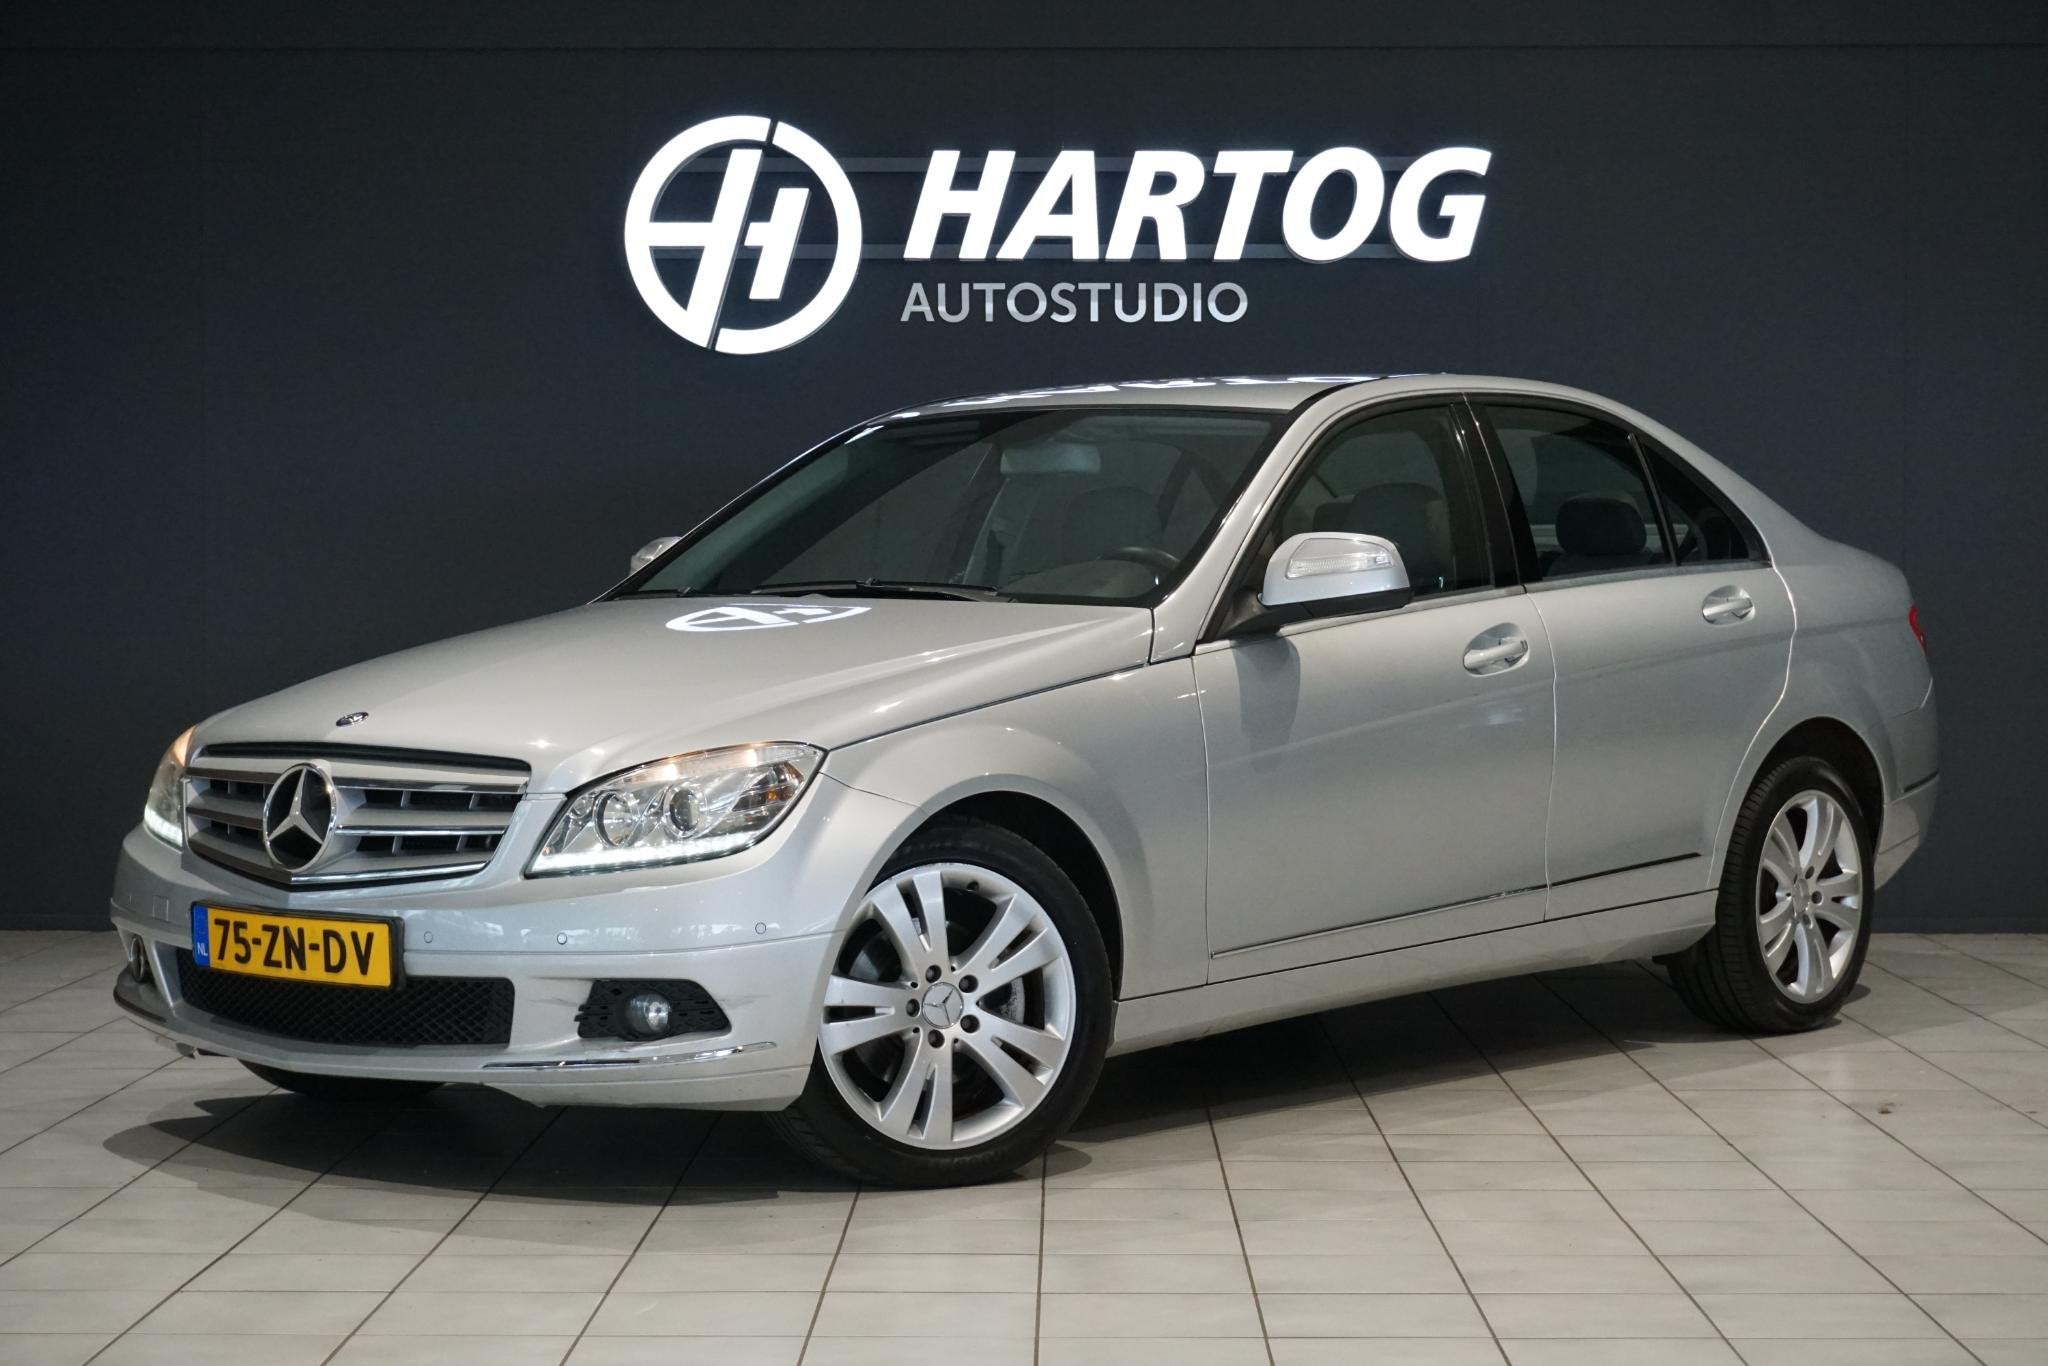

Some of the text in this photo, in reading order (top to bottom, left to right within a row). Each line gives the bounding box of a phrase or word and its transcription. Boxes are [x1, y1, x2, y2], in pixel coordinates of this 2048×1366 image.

[902, 147, 1492, 262] HARTOG
[901, 282, 1248, 323] AUTOSTUDIO
[196, 942, 209, 956] NL
[214, 918, 374, 976] 75-ZN-DV
